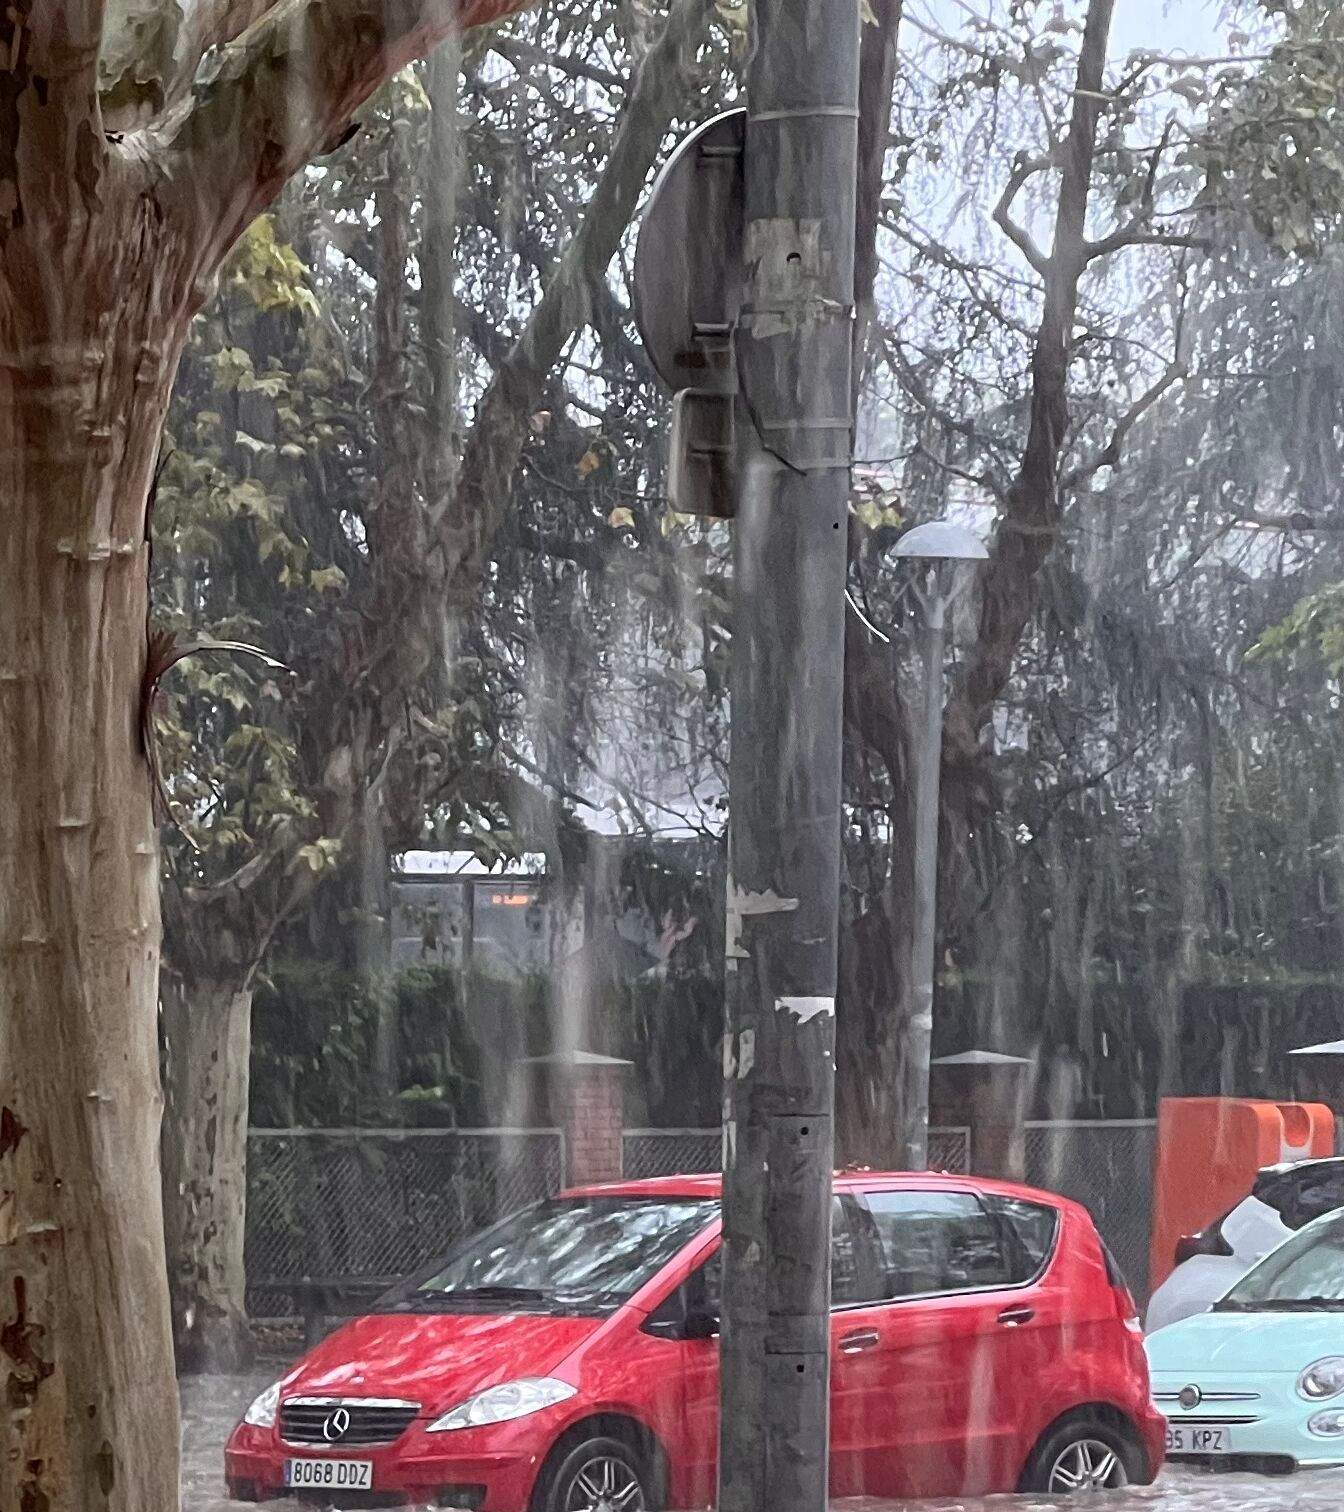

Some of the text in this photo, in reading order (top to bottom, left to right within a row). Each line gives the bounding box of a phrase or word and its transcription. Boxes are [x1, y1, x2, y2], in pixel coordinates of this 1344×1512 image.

[1192, 1429, 1223, 1451] KPZ
[294, 1462, 369, 1486] 8068 DDZ
